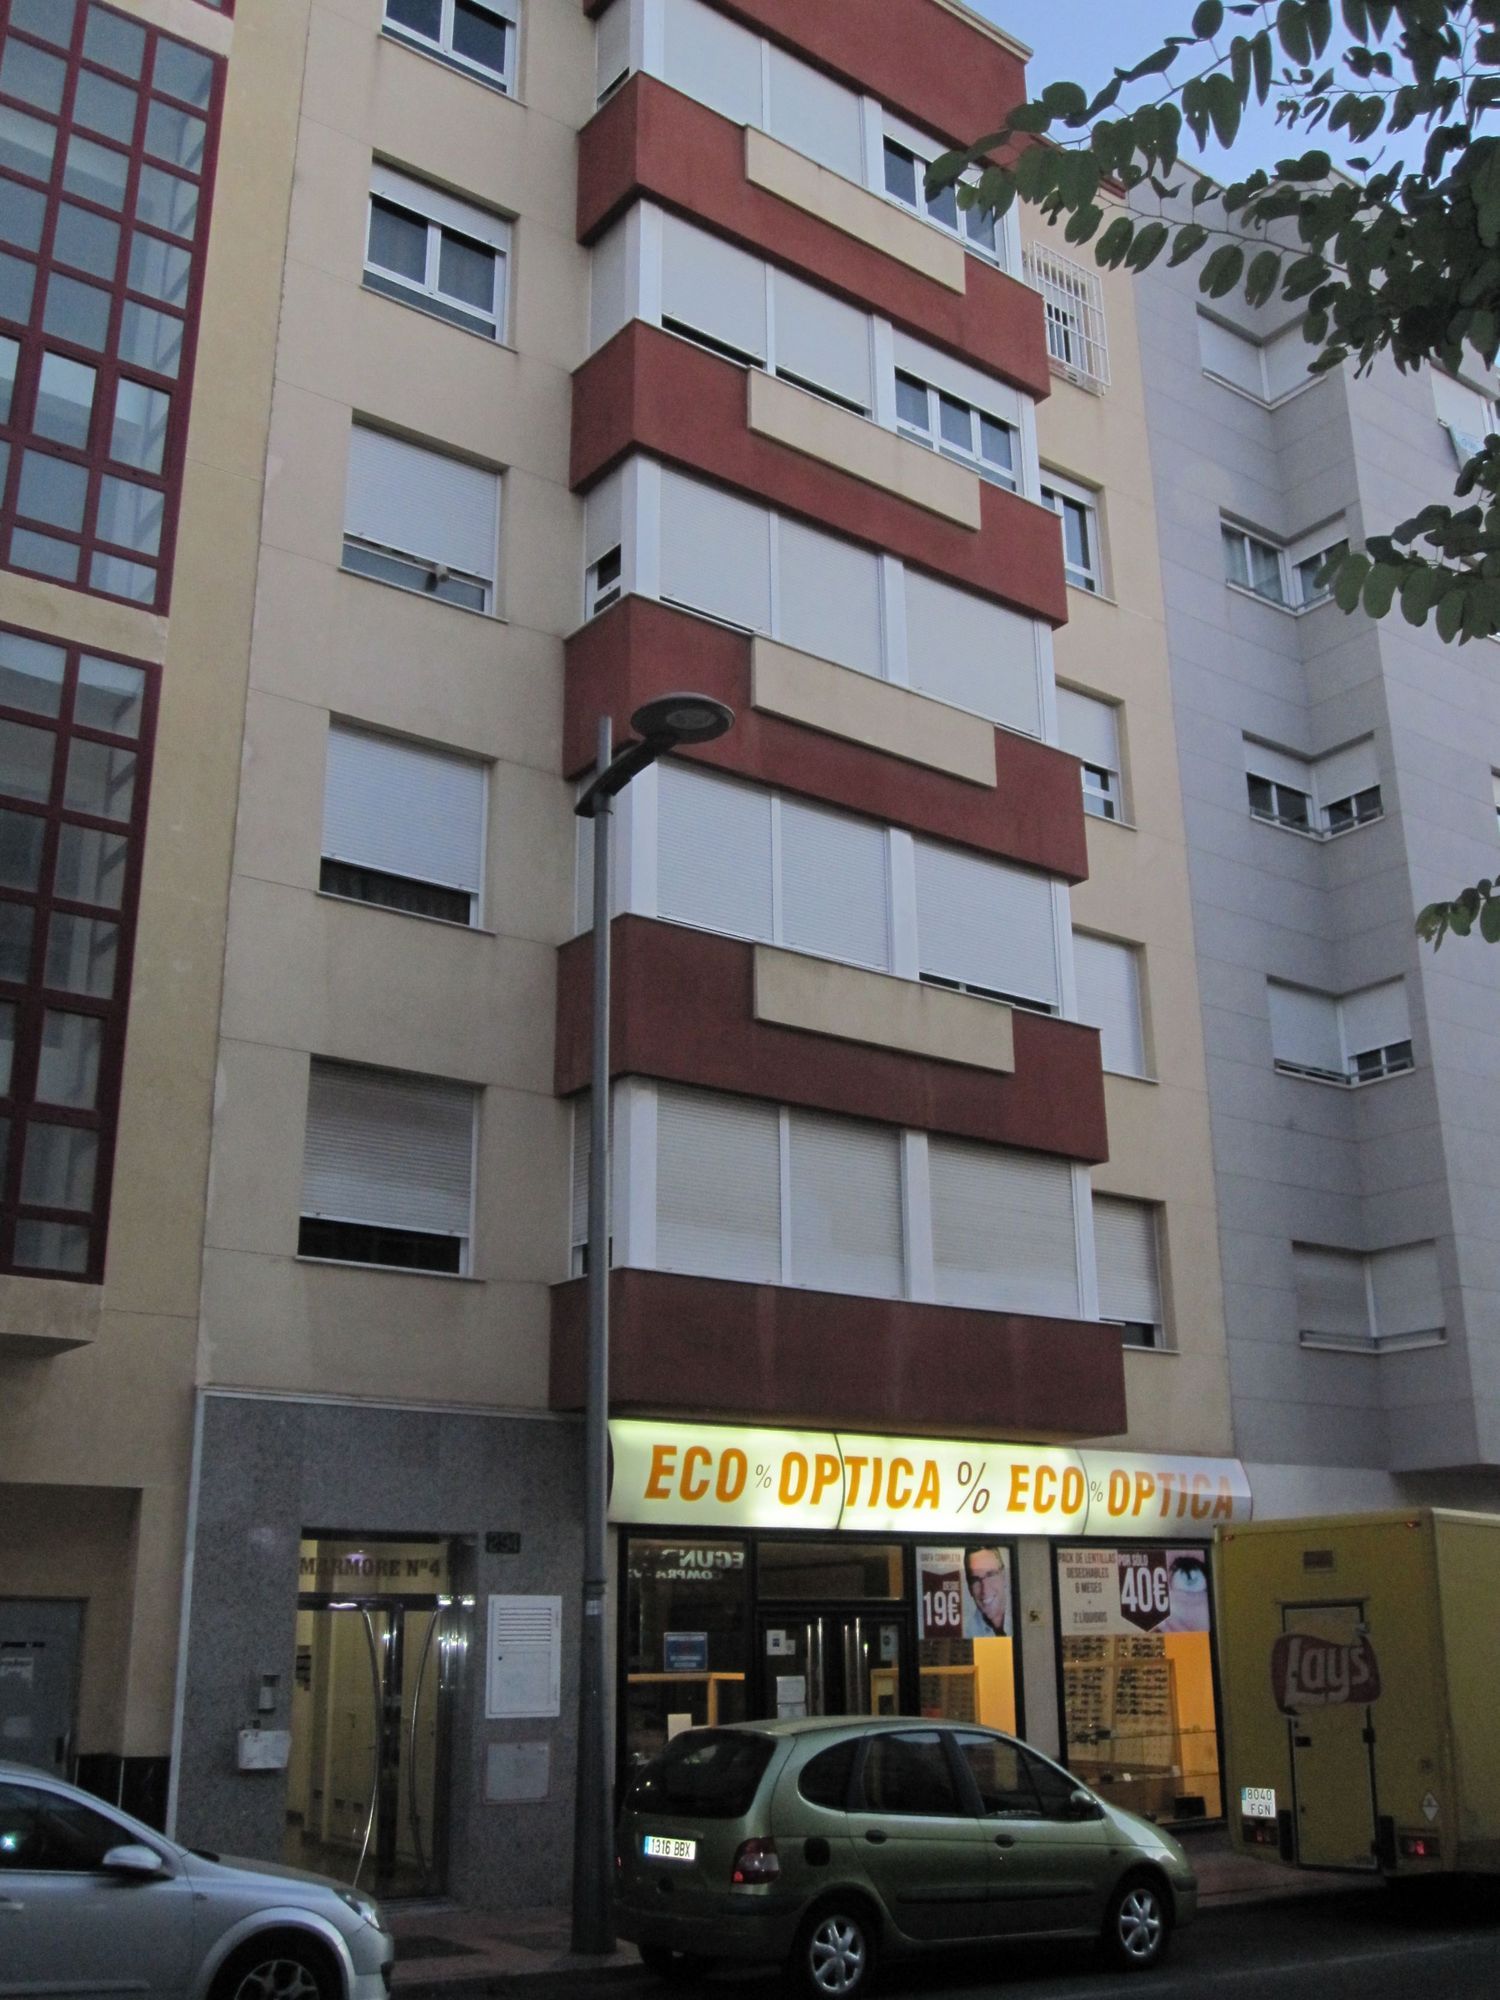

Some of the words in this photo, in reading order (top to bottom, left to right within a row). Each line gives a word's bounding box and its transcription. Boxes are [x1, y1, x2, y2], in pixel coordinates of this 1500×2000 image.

[643, 1445, 748, 1503] ECO
[777, 1451, 940, 1510] OPTICA
[1006, 1463, 1086, 1516] ECO
[1107, 1469, 1234, 1520] OPTICA
[1074, 1552, 1082, 1564] DE
[1083, 1552, 1116, 1564] LENTILLAS
[1118, 1554, 1131, 1566] POR
[1066, 1567, 1110, 1579] DESECHABLES
[1080, 1582, 1103, 1594] MESES
[1121, 1566, 1169, 1612] 40€
[922, 1591, 960, 1627] 19€
[1247, 1788, 1272, 1801] 8040
[1250, 1803, 1271, 1816] FGN
[651, 1838, 672, 1855] 1316
